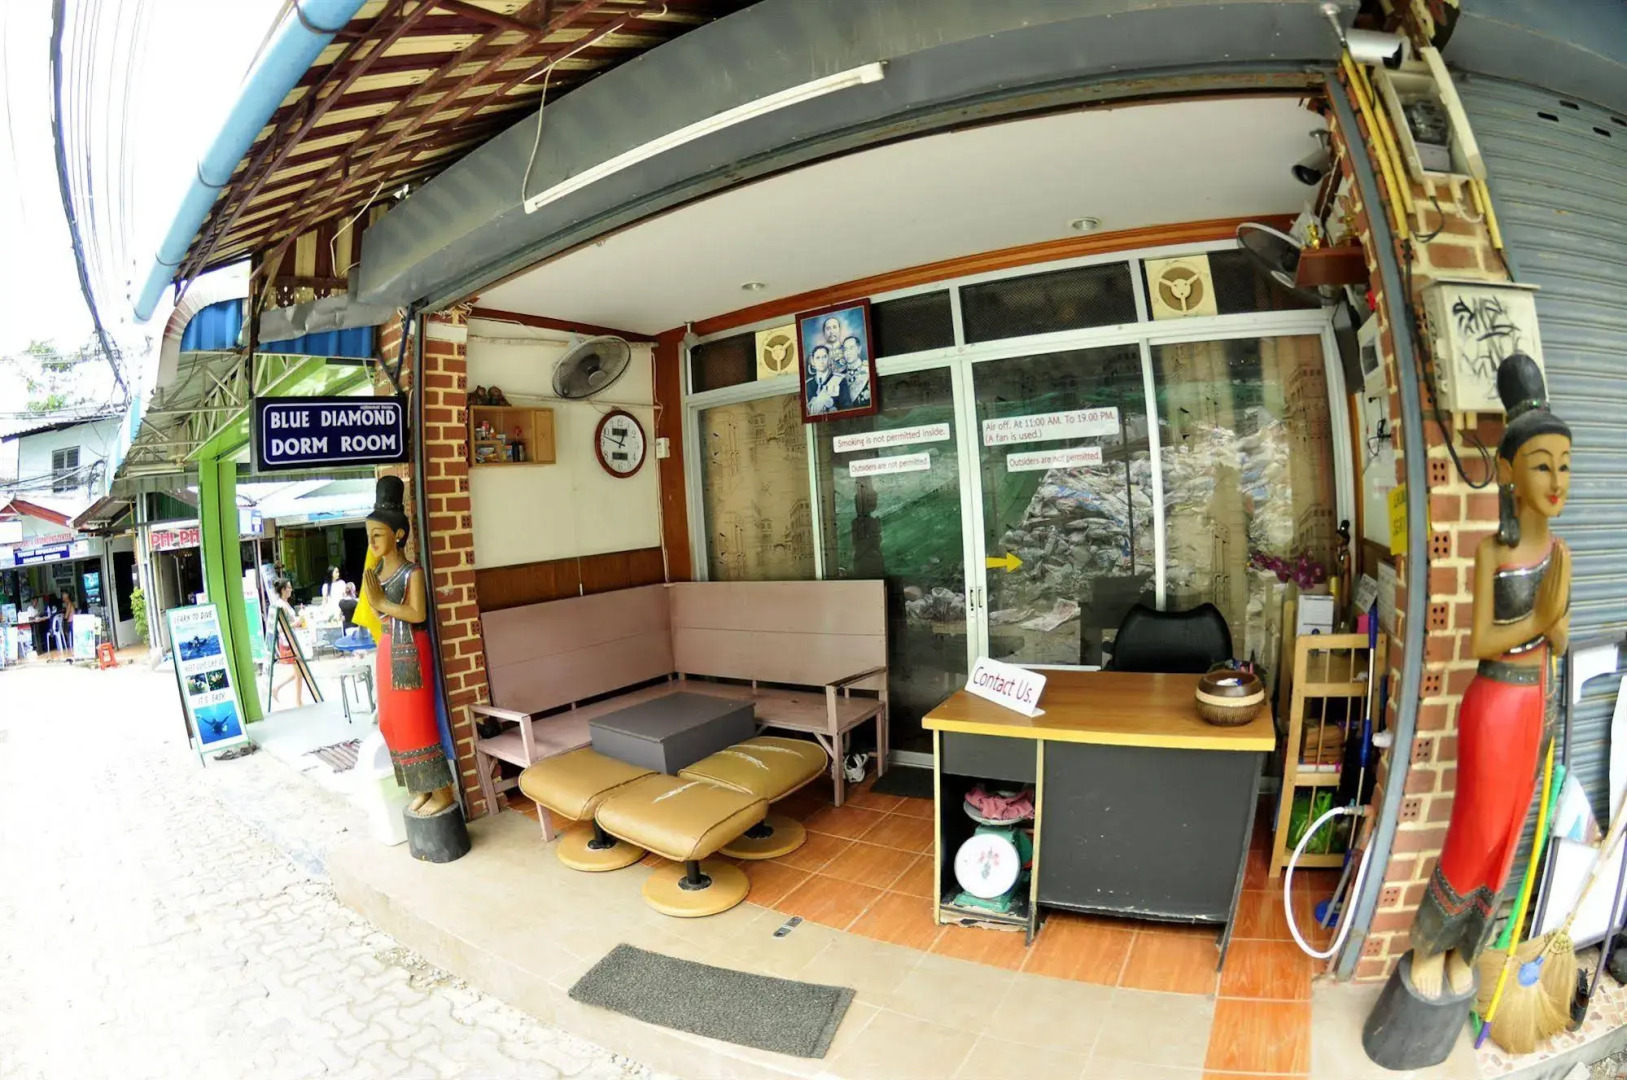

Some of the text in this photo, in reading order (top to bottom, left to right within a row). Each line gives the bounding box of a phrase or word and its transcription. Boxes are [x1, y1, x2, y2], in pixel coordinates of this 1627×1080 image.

[270, 410, 396, 429] BLUE DIAMOND
[986, 422, 996, 431] Air
[1013, 420, 1023, 429] At
[1024, 418, 1045, 428] 11:00
[1064, 415, 1075, 424] To
[1100, 411, 1115, 420] PM.
[838, 438, 865, 448] Smoking
[873, 435, 885, 444] not
[886, 429, 921, 443] permitted
[922, 427, 946, 437] inside.
[996, 433, 1008, 442] fan
[1010, 432, 1017, 441] is
[1019, 429, 1043, 441] used.)
[271, 434, 396, 457] DORM ROOM
[851, 462, 877, 473] Outsiders
[888, 460, 898, 469] not
[1009, 452, 1101, 468] Outsiders are not permitted.
[151, 528, 200, 549] PHI PH
[173, 610, 213, 624] LEARN TO DIVE
[973, 666, 1033, 704] Contact Us.
[211, 692, 225, 703] EASY
